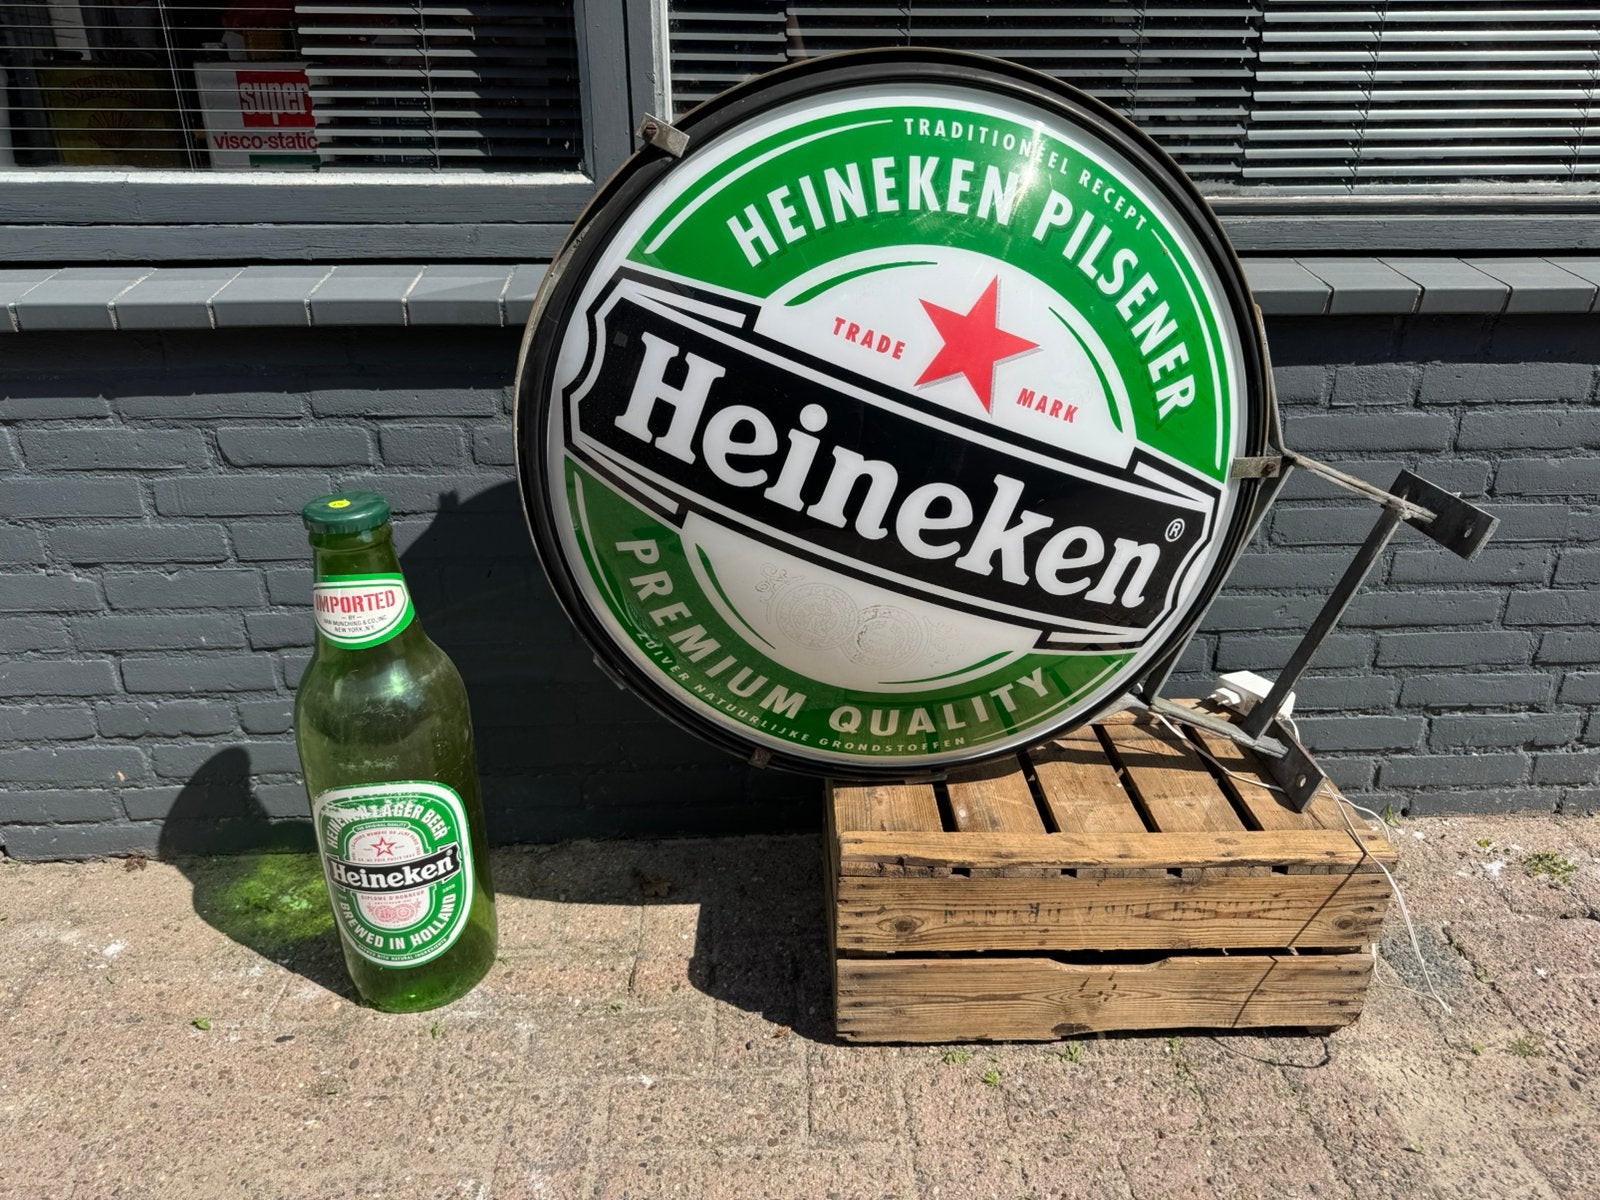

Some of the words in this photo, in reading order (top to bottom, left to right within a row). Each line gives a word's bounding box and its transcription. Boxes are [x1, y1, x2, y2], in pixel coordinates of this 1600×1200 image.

[239, 82, 309, 125] super
[213, 131, 318, 149] visco-static
[904, 118, 1070, 175] TRADITIONEEL
[1078, 169, 1147, 231] RECEPT
[726, 155, 1019, 268] HEINEKEN
[1032, 189, 1196, 421] PILSENER
[831, 316, 906, 360] TRADE
[1016, 387, 1078, 423] MARK
[614, 332, 1160, 609] Heineken
[315, 590, 396, 613] IMPORTED
[615, 539, 807, 719] PREMIUM
[828, 667, 1049, 736] QUALITY
[636, 631, 691, 681] ZUIVER
[694, 684, 809, 742] NATUURLIJKE
[819, 737, 965, 752] GRONDSTOFFEN
[421, 809, 449, 841] BEER
[330, 856, 455, 889] Heineken
[340, 902, 384, 948] BREWED
[389, 937, 406, 950] IN
[410, 892, 456, 947] HOLLAND
